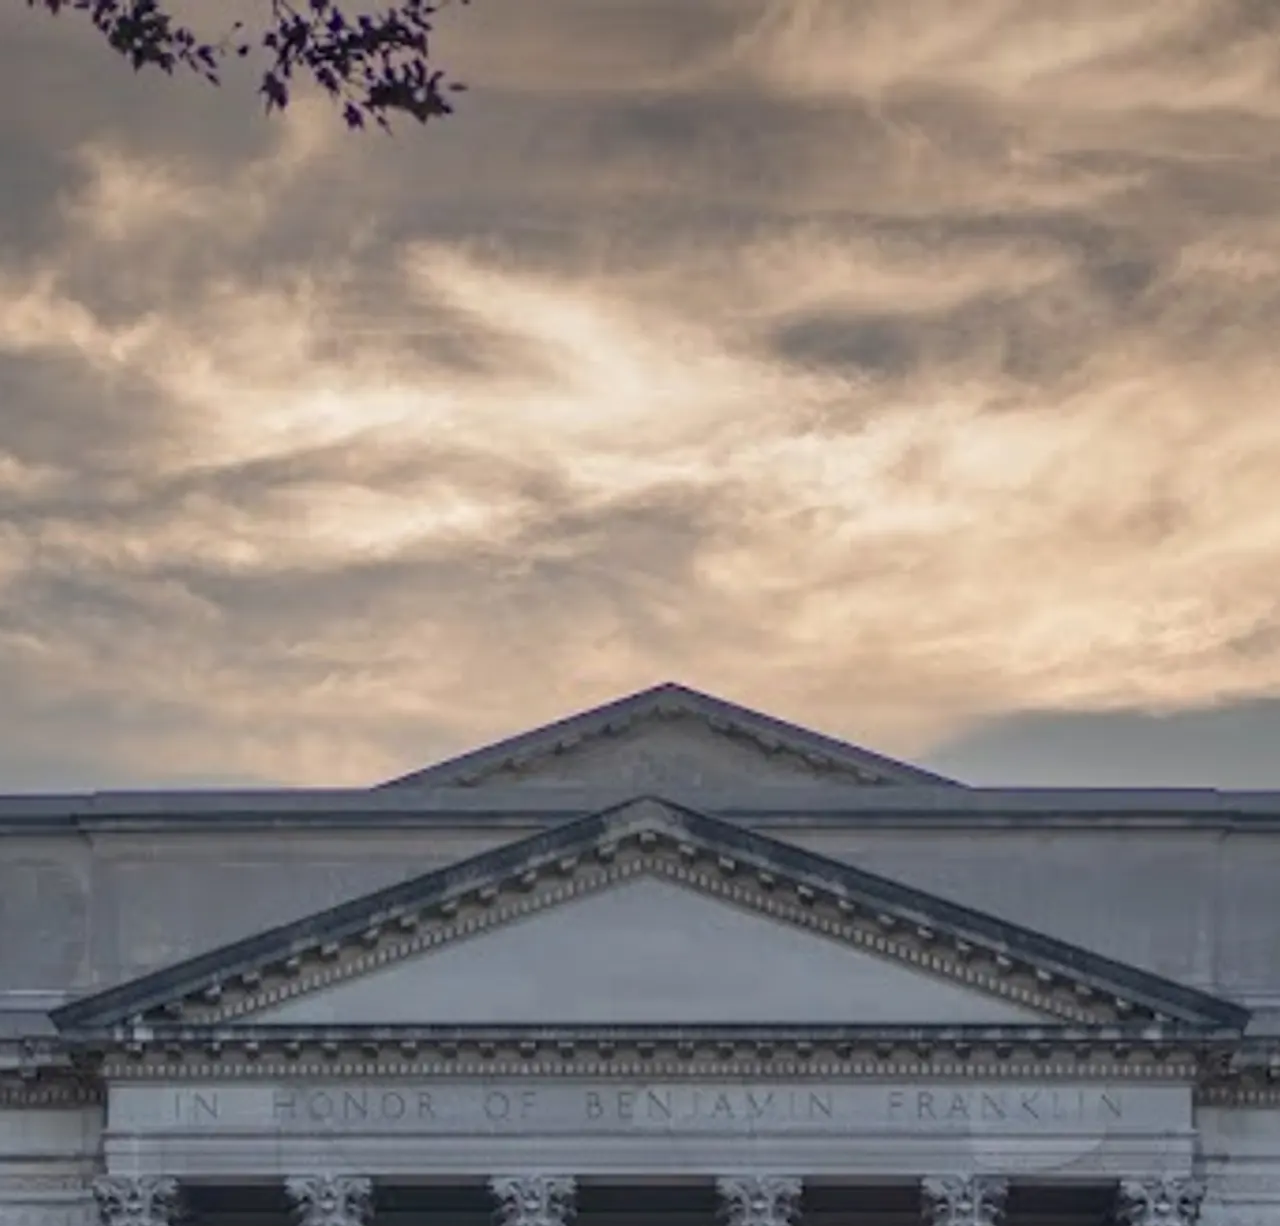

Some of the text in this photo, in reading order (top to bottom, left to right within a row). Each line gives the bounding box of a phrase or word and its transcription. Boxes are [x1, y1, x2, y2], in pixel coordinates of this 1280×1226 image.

[174, 1090, 1122, 1121] IN HONOR OF BENJAMIN FRANKLIN
